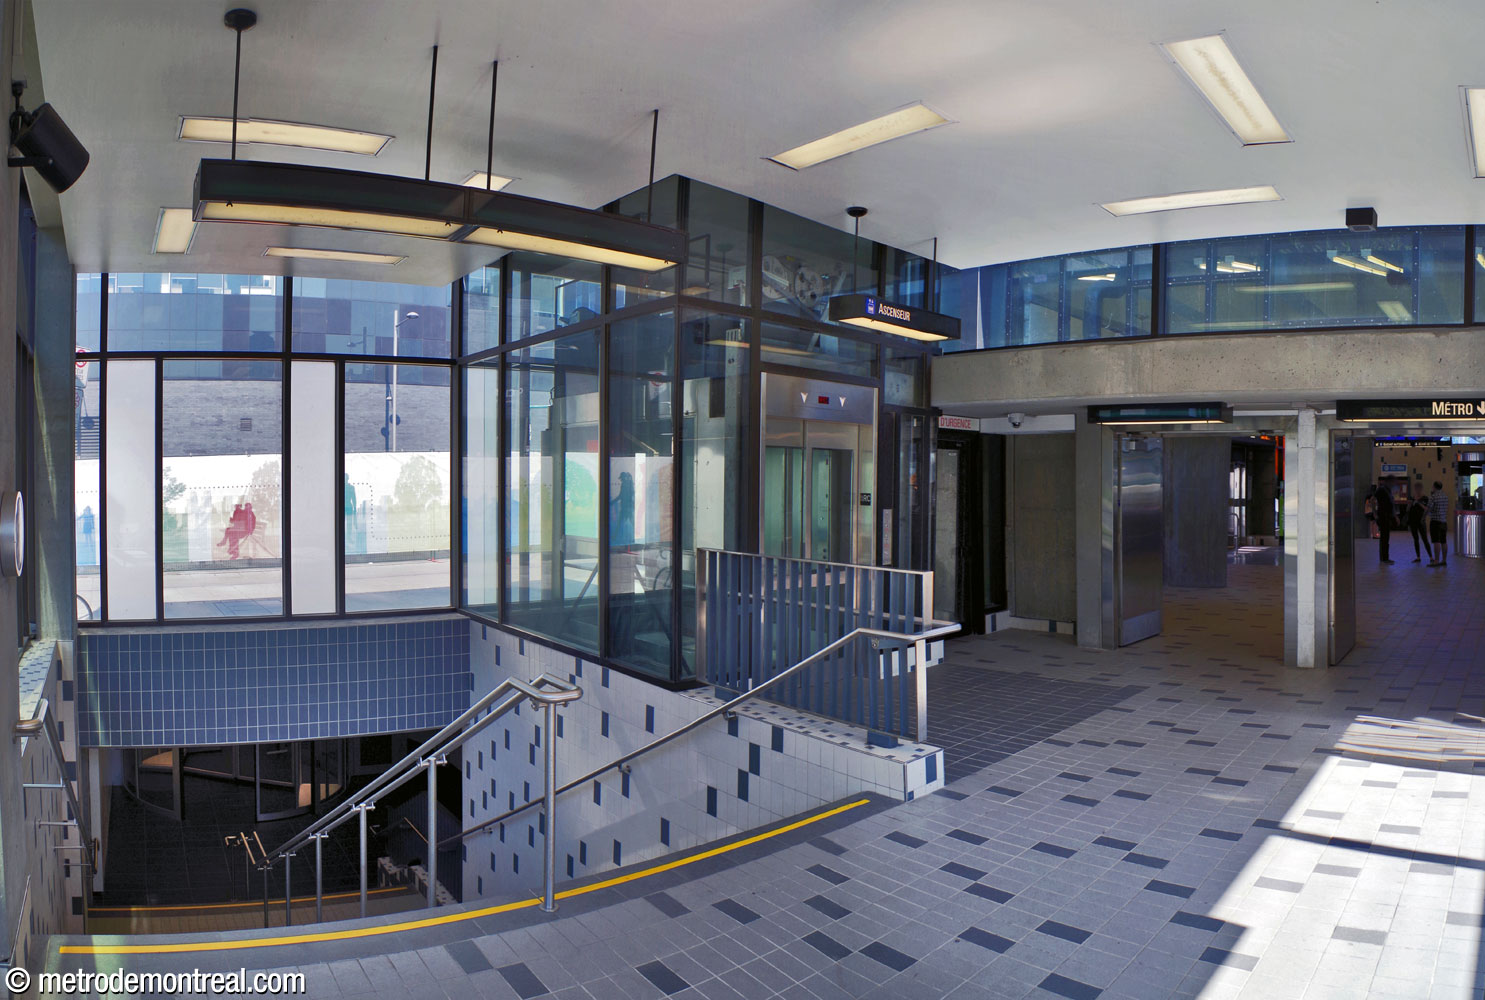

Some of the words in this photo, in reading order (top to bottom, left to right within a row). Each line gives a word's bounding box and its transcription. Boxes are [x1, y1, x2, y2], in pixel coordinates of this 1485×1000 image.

[878, 303, 911, 321] ASCENSEUR
[1432, 401, 1473, 416] MÉTRO
[940, 417, 972, 429] D'URGENCE
